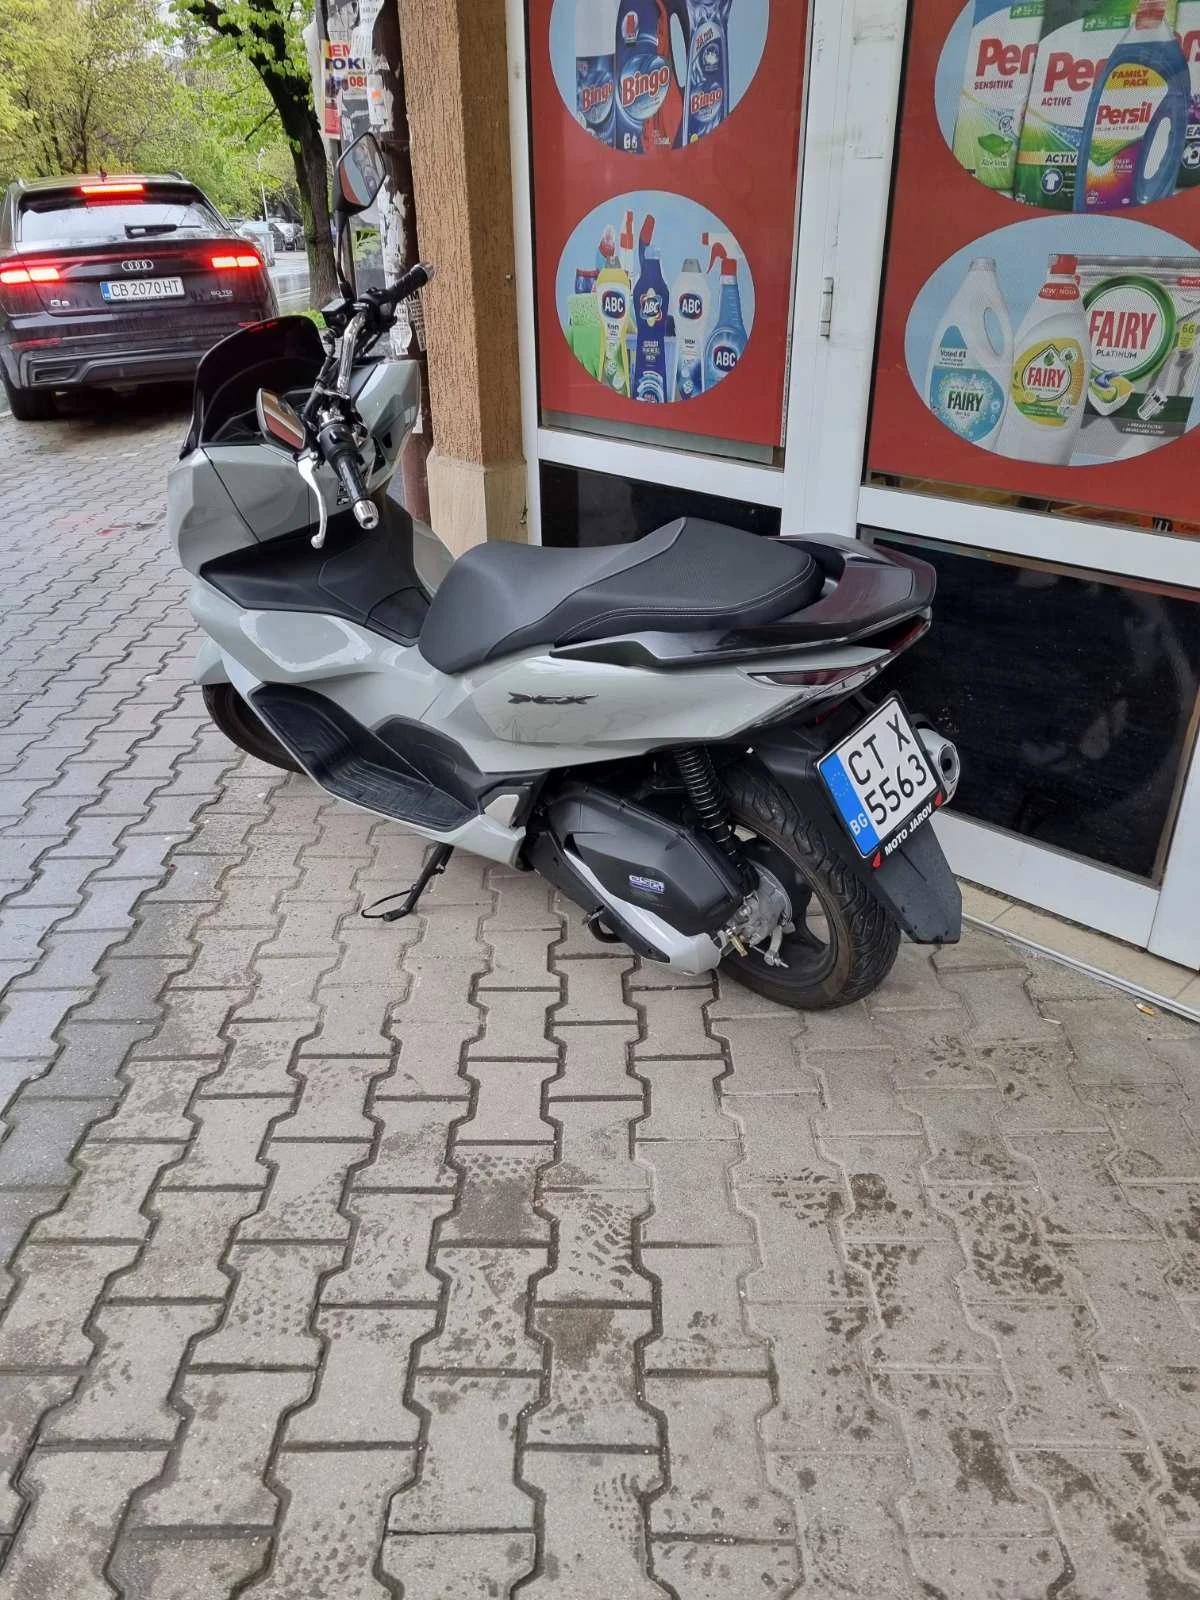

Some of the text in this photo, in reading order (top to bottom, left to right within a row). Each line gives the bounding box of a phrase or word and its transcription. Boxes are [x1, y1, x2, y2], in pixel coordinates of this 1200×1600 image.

[1112, 70, 1149, 79] FAMILY
[1123, 79, 1148, 87] PACK
[622, 65, 669, 107] Bingo
[974, 80, 1014, 90] SENSITIVE
[582, 80, 613, 112] Bingo
[691, 88, 722, 113] Bingo
[1041, 97, 1072, 106] ACTIVE
[1096, 101, 1152, 125] Persil
[112, 280, 179, 297] CB 2070 HT
[604, 297, 623, 312] ABC
[643, 302, 659, 313] ABC
[682, 299, 700, 313] ABC
[1089, 311, 1156, 350] FAIRY
[1182, 324, 1194, 333] 66
[716, 352, 735, 366] ABC
[1096, 350, 1137, 359] PLATINUM
[1026, 367, 1066, 388] FAIRY
[948, 390, 984, 411] FAIRY
[848, 713, 910, 785] CT X
[864, 754, 926, 825] 5563
[850, 812, 868, 836] BG
[884, 802, 933, 856] MOTO JAROV
